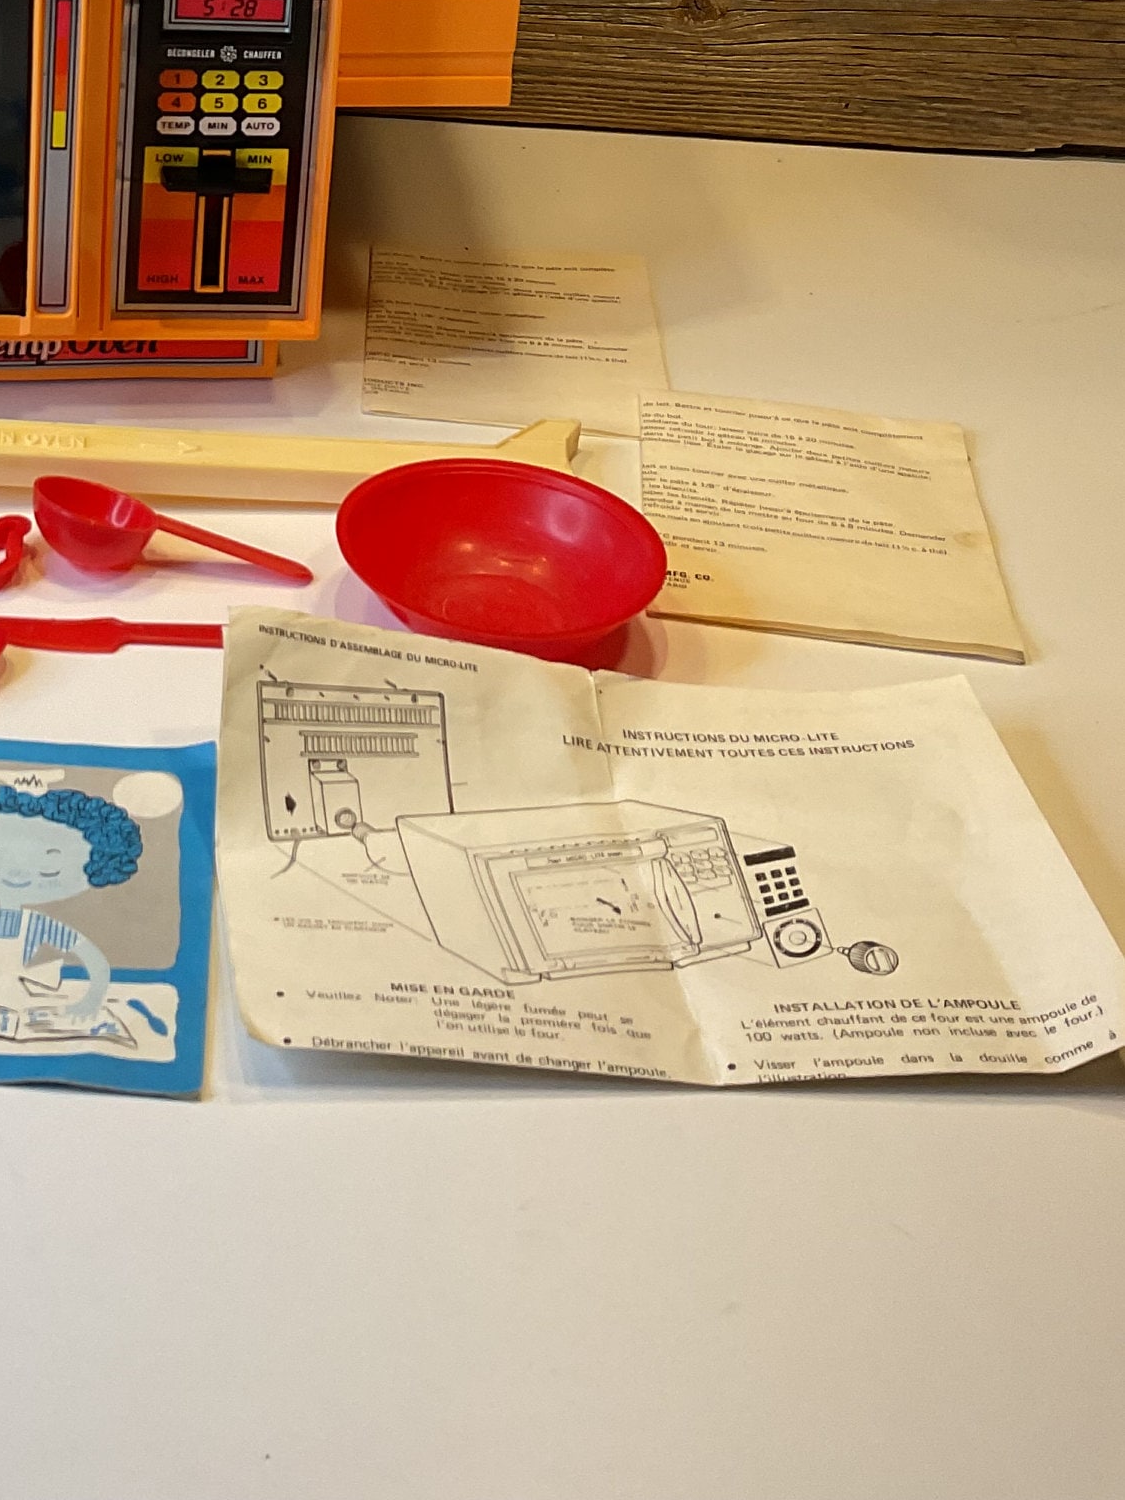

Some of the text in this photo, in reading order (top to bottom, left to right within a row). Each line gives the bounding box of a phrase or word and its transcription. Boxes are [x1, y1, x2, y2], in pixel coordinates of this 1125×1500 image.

[243, 50, 282, 60] CHAUFFER
[174, 73, 269, 86] 1 2 3
[172, 97, 268, 109] 4 5 6
[161, 121, 275, 130] TEMP MIN AUTO
[155, 153, 185, 163] LOW
[247, 155, 272, 164] MIN
[146, 274, 179, 284] HIGH
[238, 275, 265, 285] MAX
[25, 432, 88, 450] OVEN
[259, 624, 479, 673] INSTRUCTIONS D'ASSEMBLAGE DU MICRO-LITE
[622, 728, 840, 744] INSTRUCTIONS DU MICRO-LITE
[562, 734, 916, 759] LIRE ATTENTIVEMENT TOUTES CES INSTRUCTIONS
[390, 982, 516, 1000] MISE EN GARDE
[740, 992, 1099, 1030] L'élément chauffant de ce four est une ampoule de
[773, 998, 1021, 1014] INSTALLATION DE L'AMPOULE
